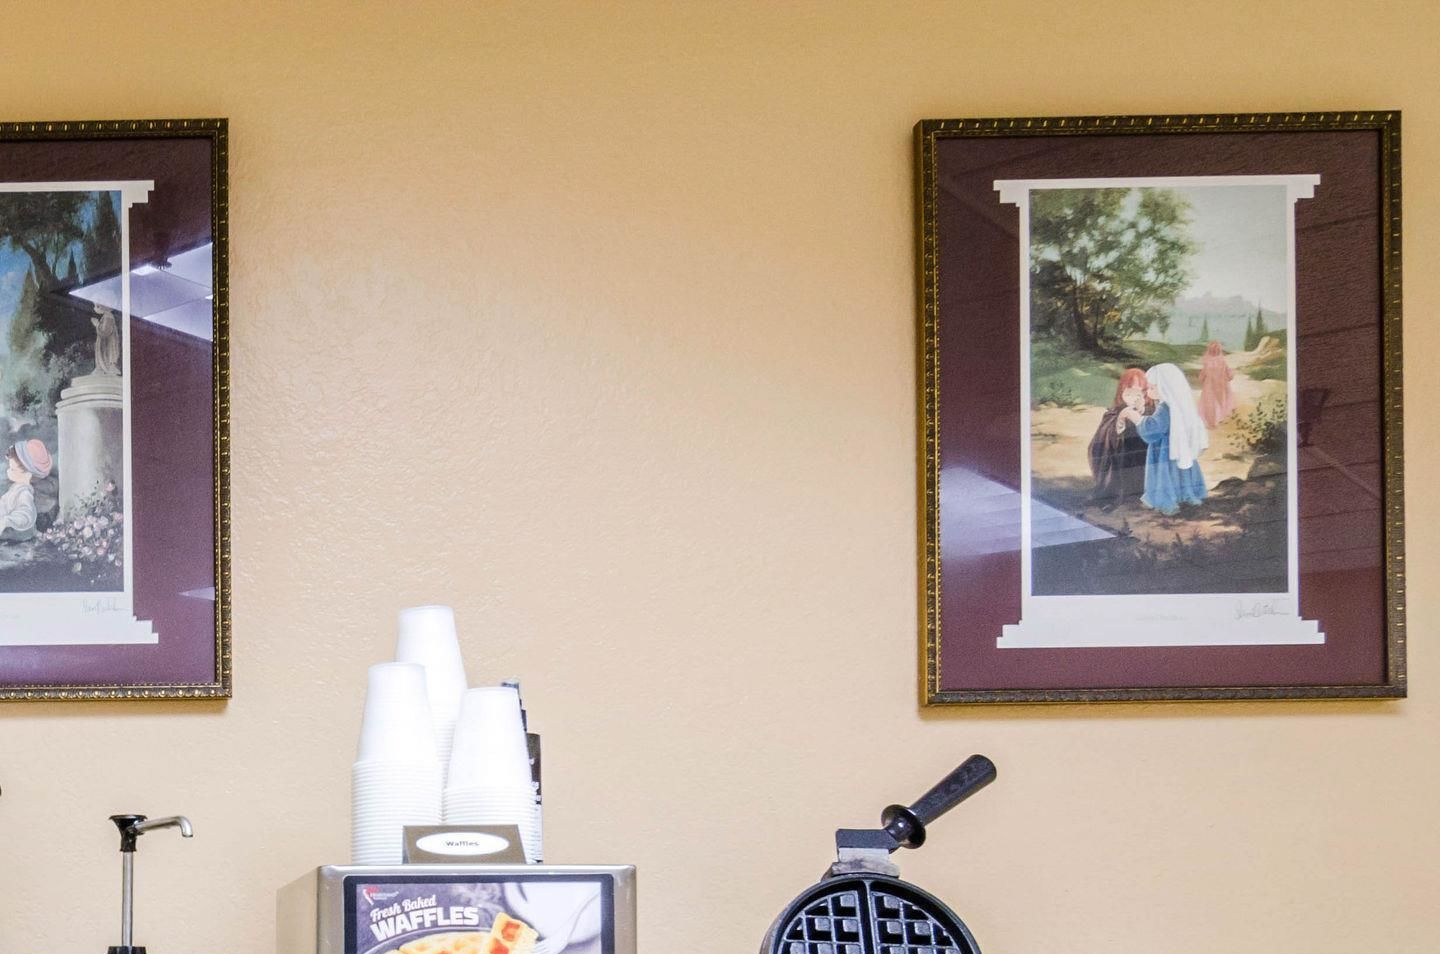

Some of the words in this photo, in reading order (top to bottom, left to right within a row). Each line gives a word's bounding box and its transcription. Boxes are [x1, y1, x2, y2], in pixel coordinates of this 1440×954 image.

[369, 906, 479, 941] WAFFLES
[370, 903, 401, 922] Fresh
[402, 894, 437, 912] Baked
